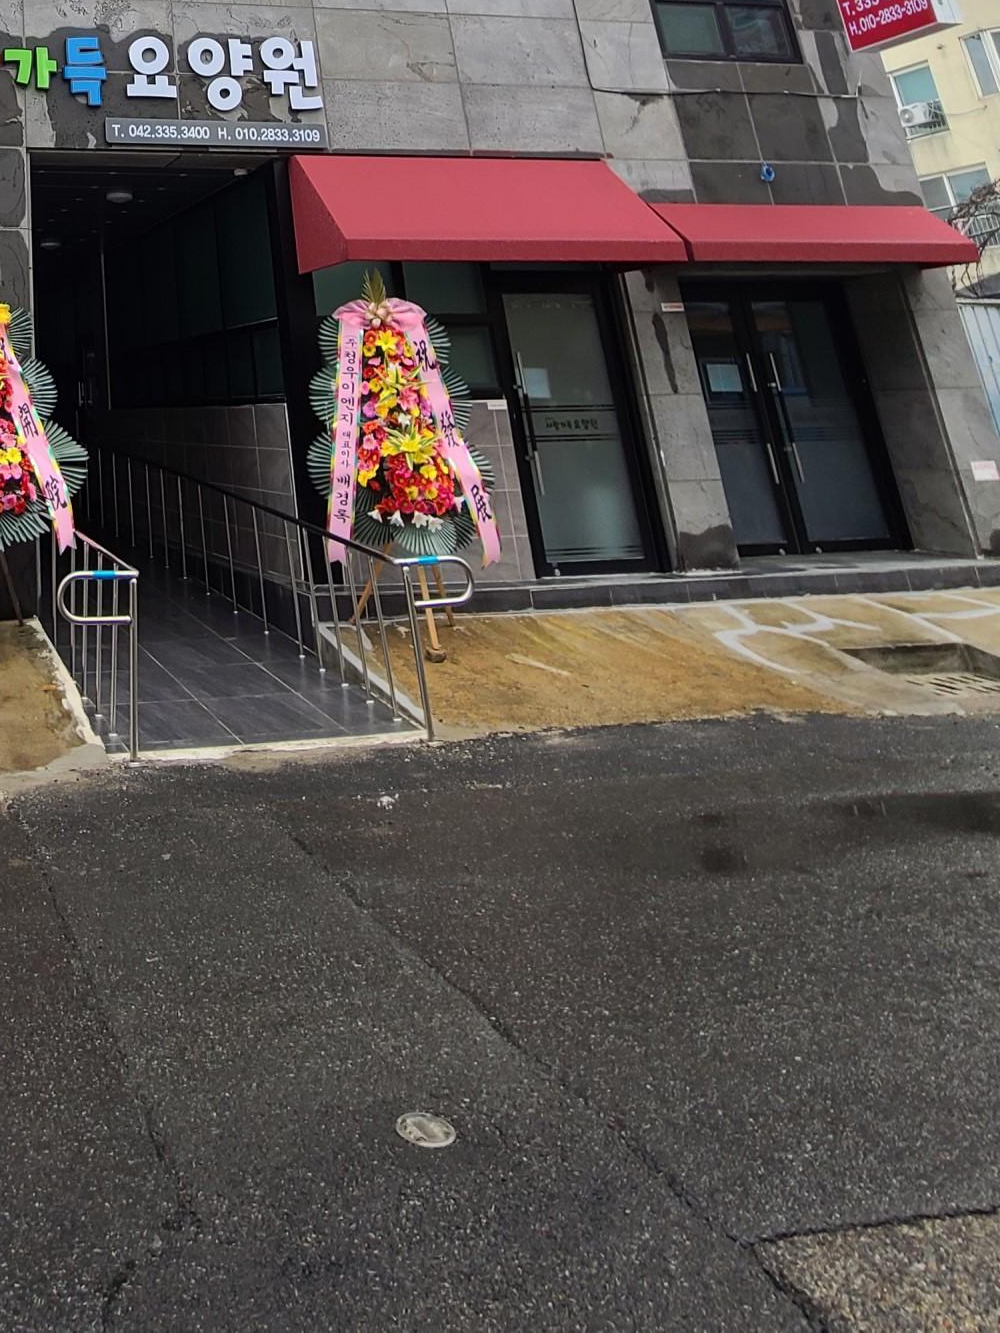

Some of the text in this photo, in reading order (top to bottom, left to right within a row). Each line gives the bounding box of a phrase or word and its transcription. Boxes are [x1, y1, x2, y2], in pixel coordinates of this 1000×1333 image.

[127, 36, 323, 111] 요양원
[129, 125, 210, 139] 042.335.3400
[236, 127, 320, 142] 010.2833.3109
